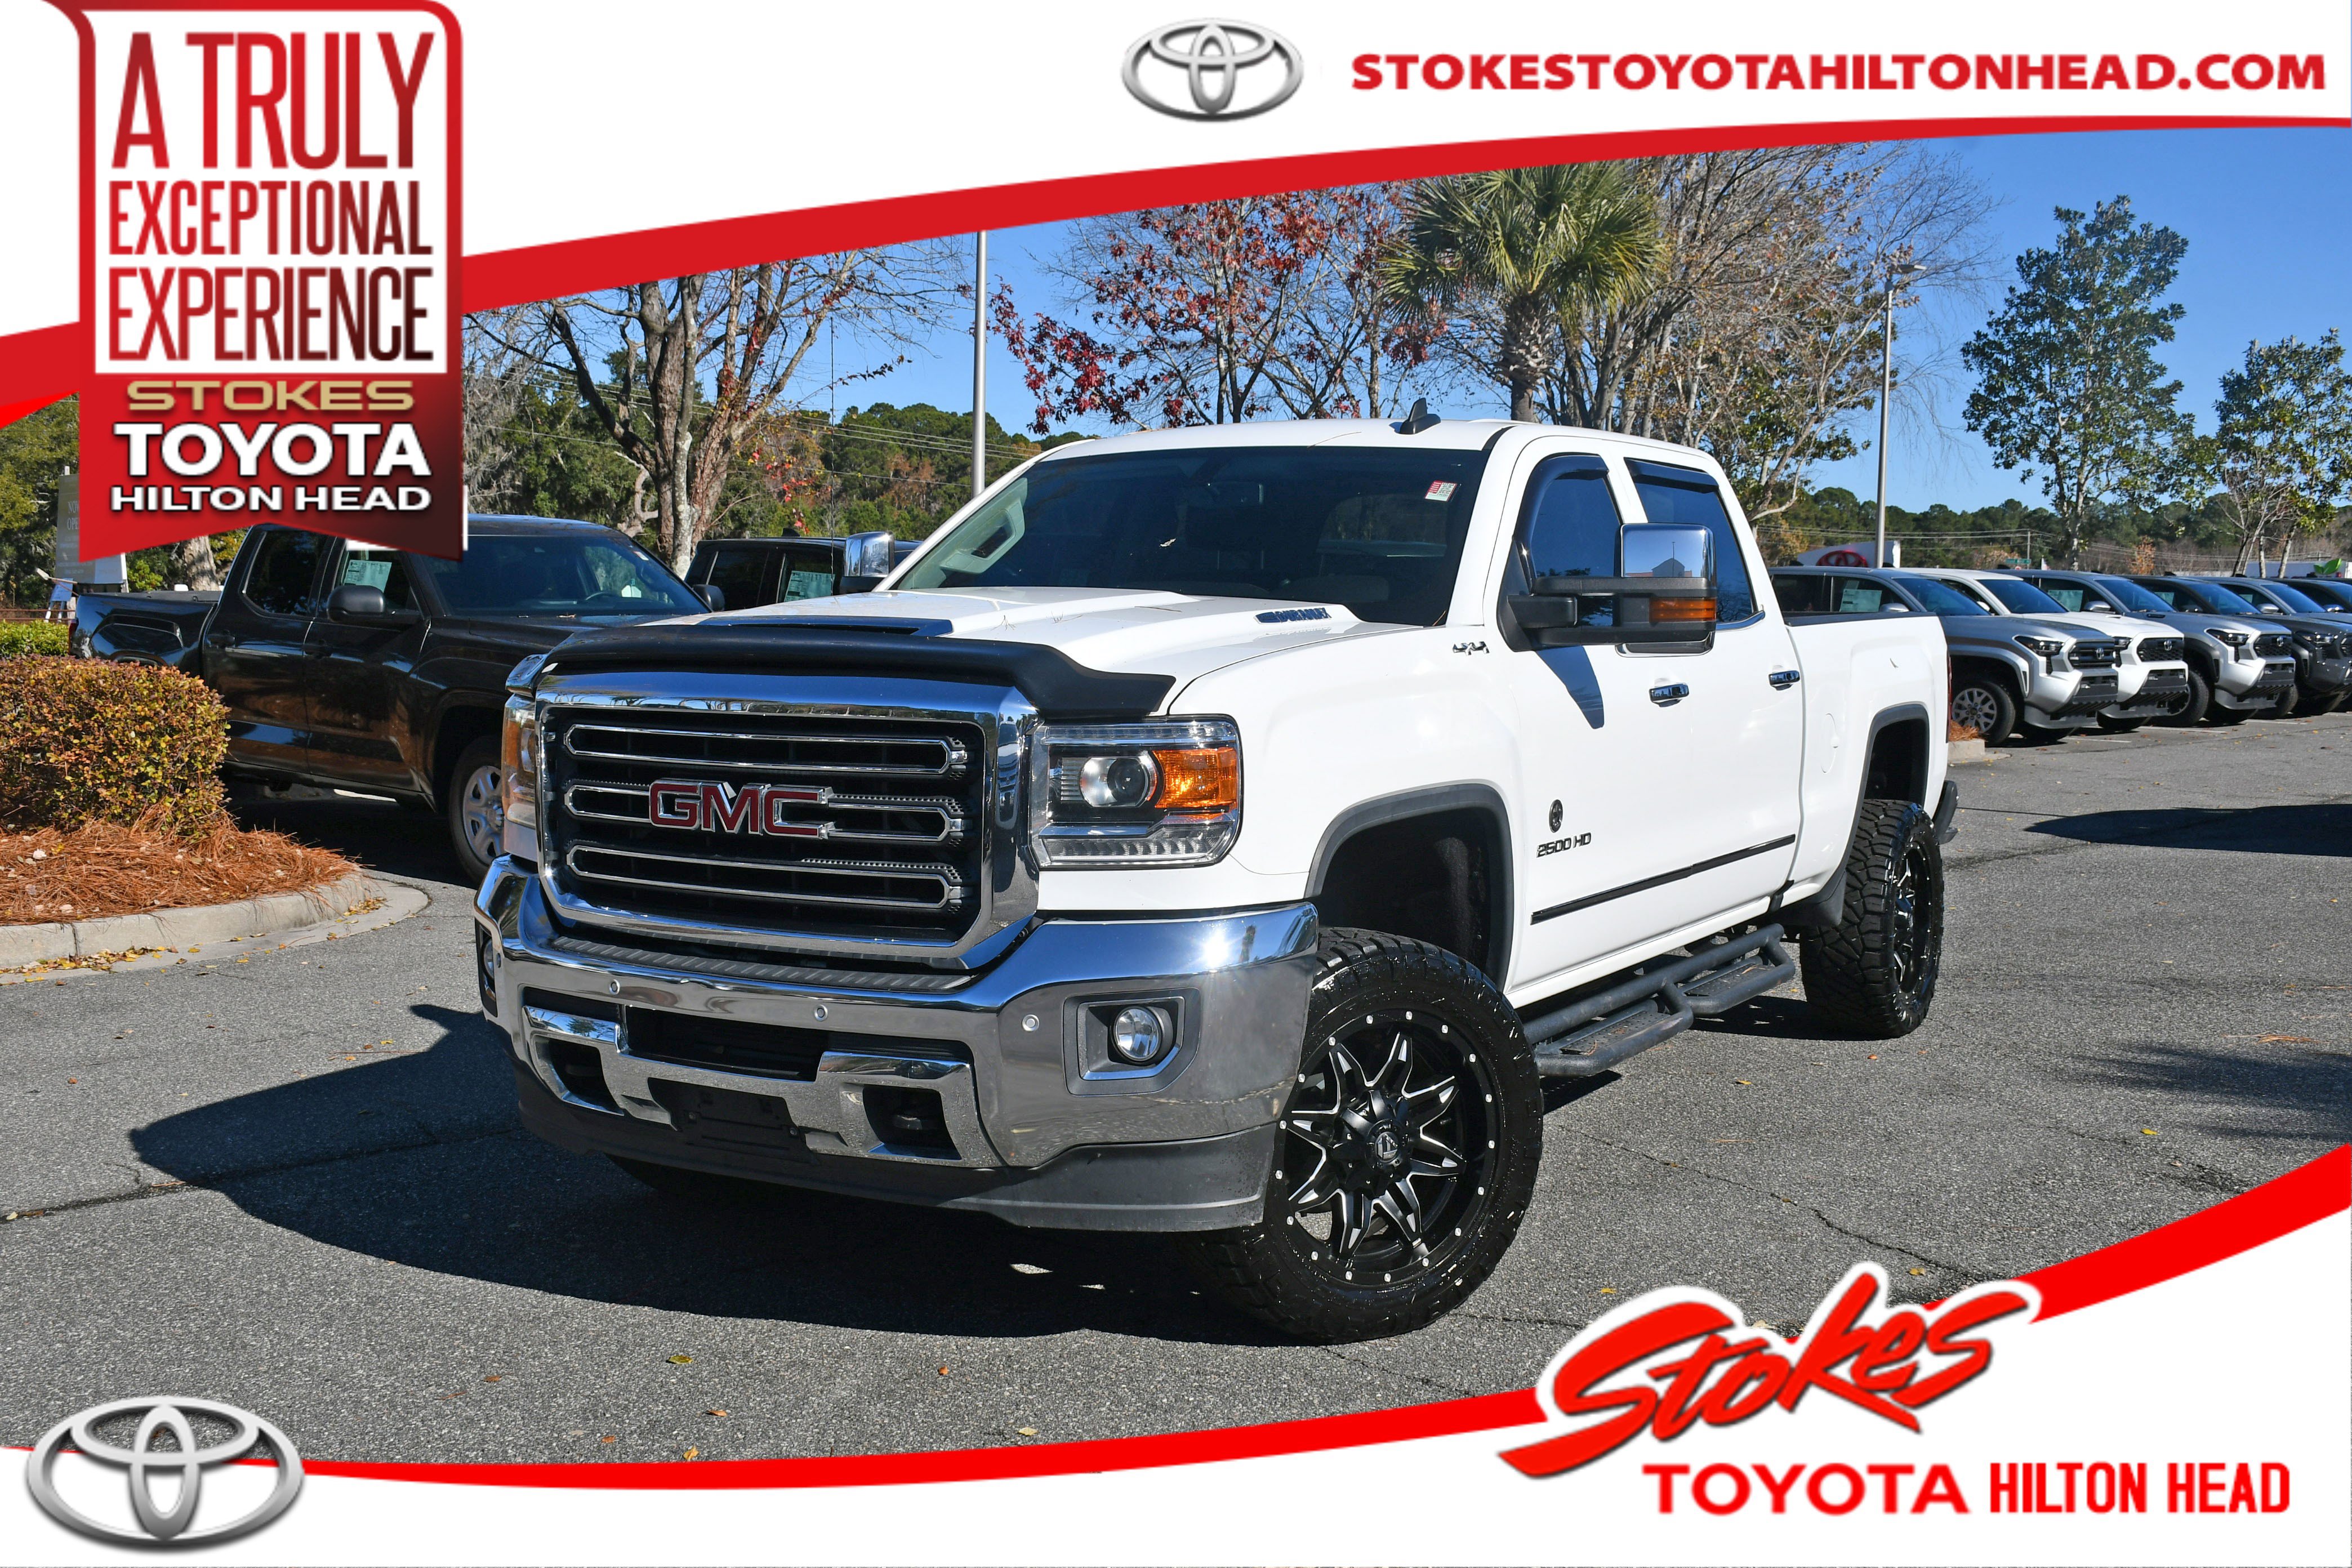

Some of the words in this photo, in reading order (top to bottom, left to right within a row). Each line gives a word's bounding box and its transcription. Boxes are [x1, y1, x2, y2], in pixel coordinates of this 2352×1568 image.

[67, 518, 79, 531] OPE
[649, 779, 832, 839] GMC
[1536, 837, 1572, 858] 2500
[1573, 832, 1592, 849] HD
